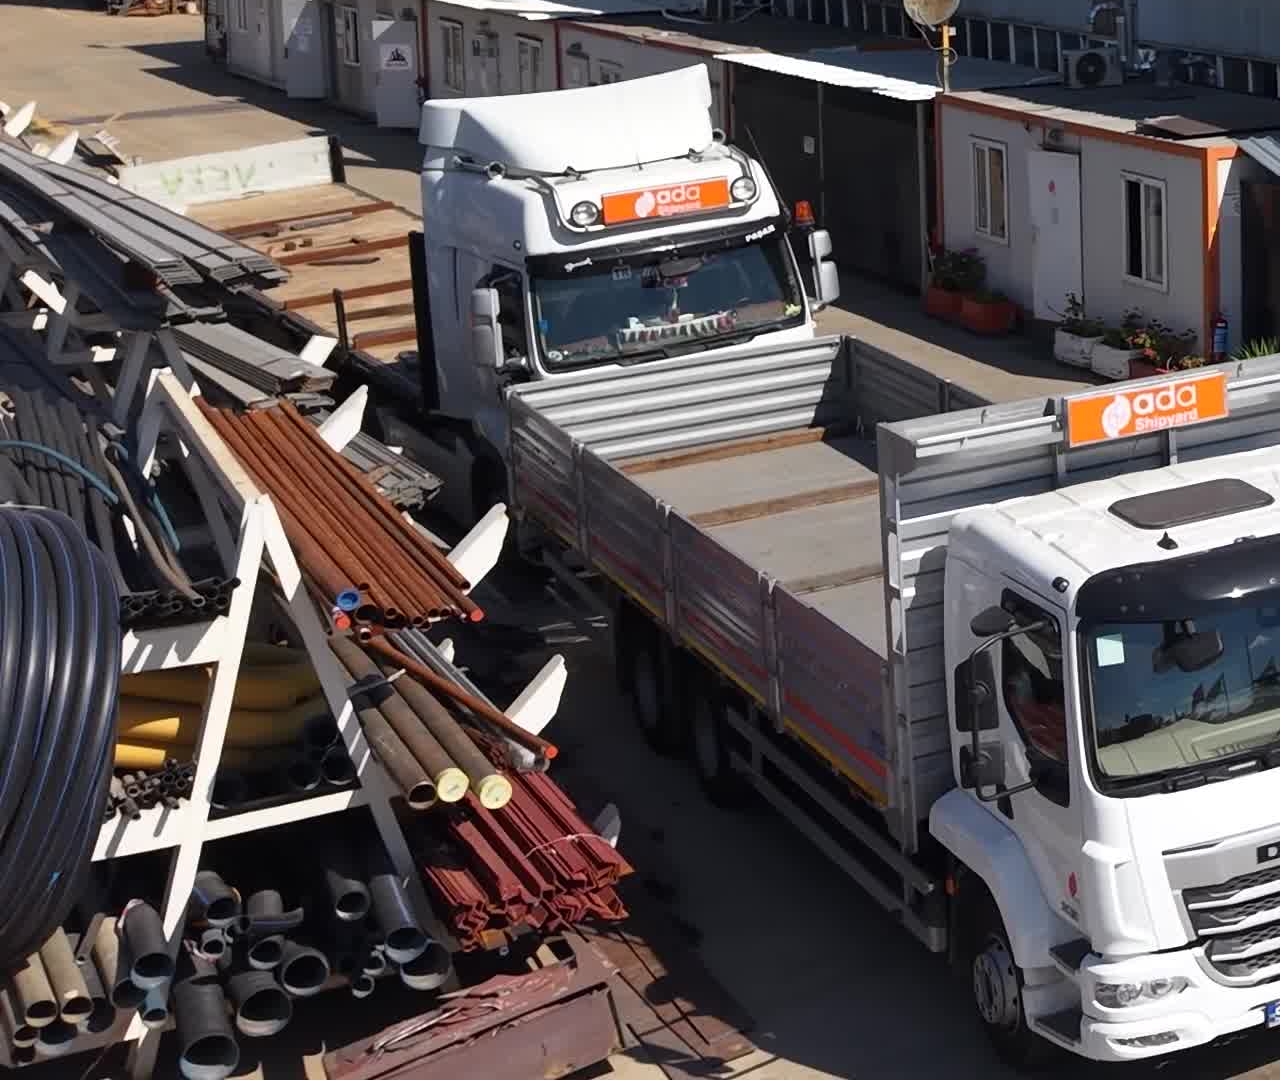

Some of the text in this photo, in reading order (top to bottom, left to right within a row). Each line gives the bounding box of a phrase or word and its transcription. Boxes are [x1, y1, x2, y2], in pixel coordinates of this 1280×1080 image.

[656, 184, 700, 205] ada
[1133, 383, 1198, 415] ada
[1134, 408, 1199, 431] Shipyard
